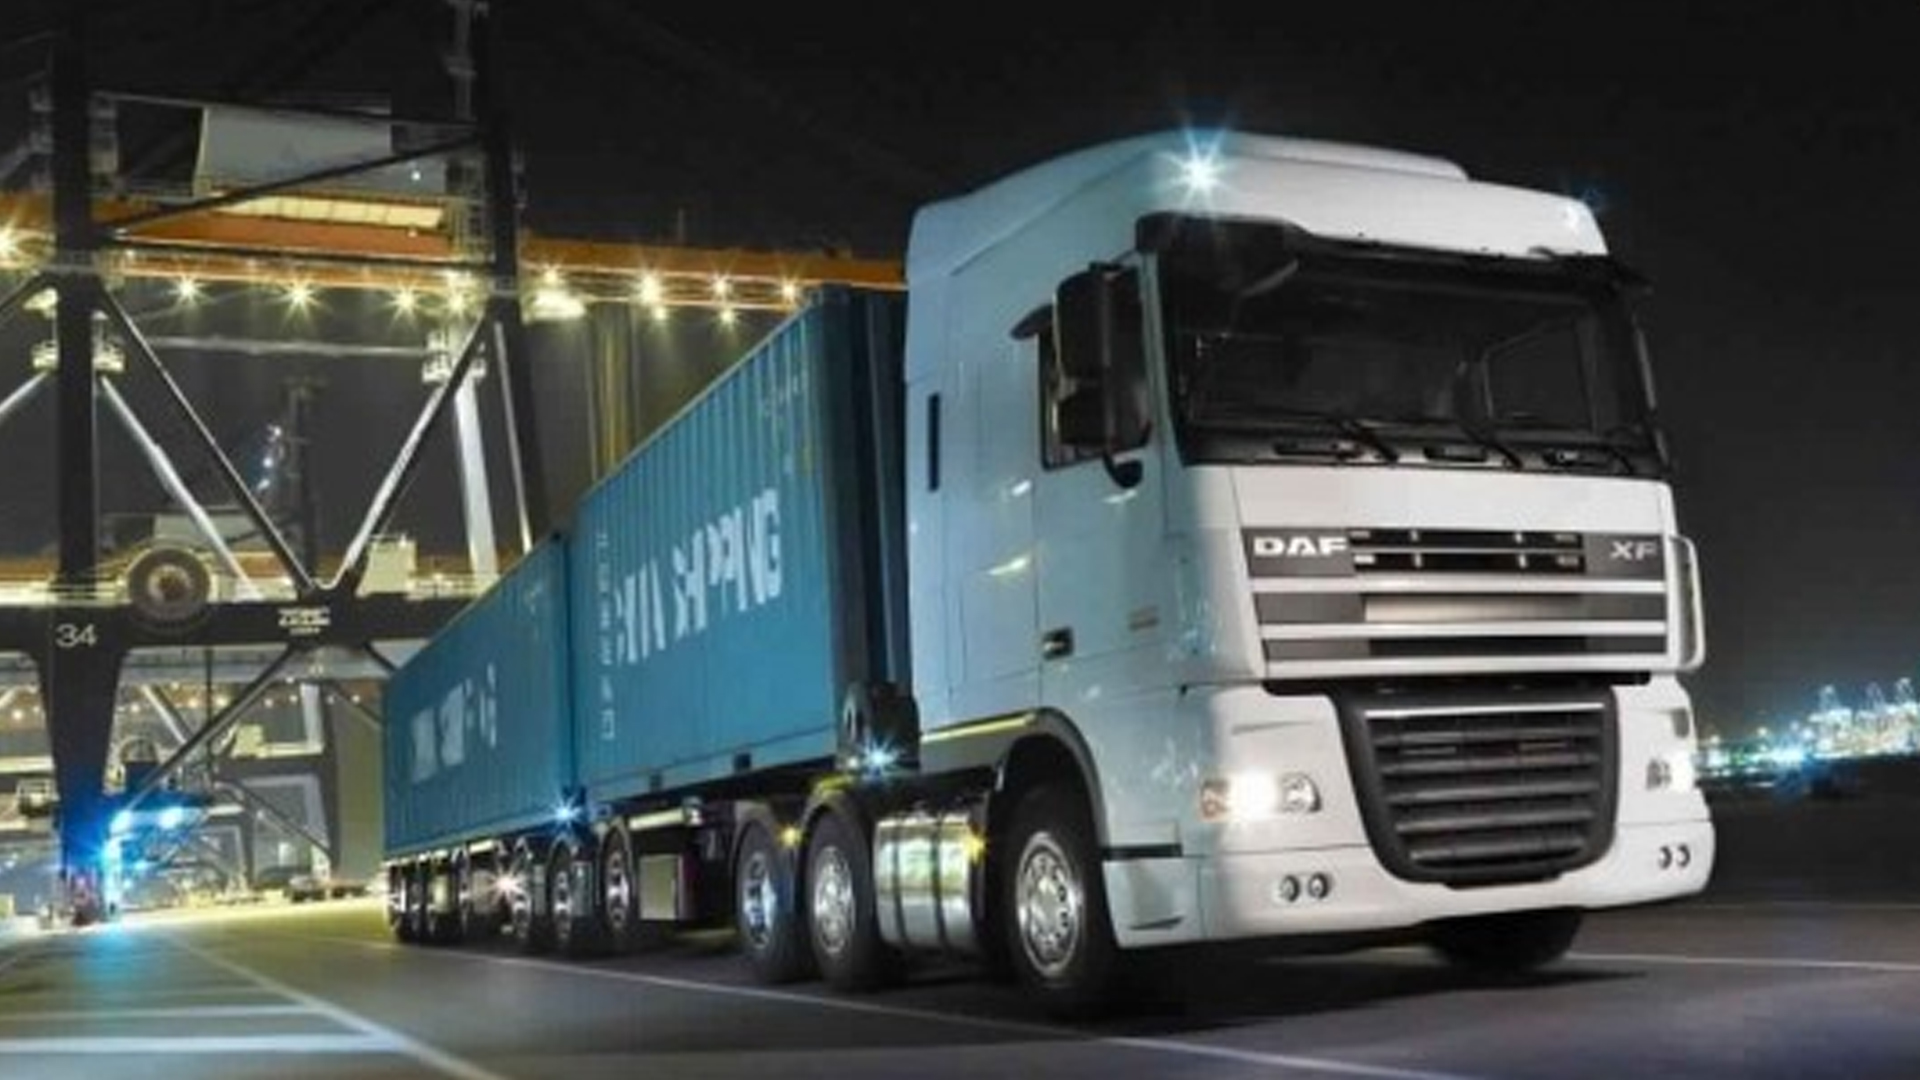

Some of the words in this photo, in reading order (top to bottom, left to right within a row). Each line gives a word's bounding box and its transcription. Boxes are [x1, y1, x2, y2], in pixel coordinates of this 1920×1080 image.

[1254, 537, 1347, 557] DAF
[1609, 541, 1658, 560] XF
[56, 623, 97, 648] 34
